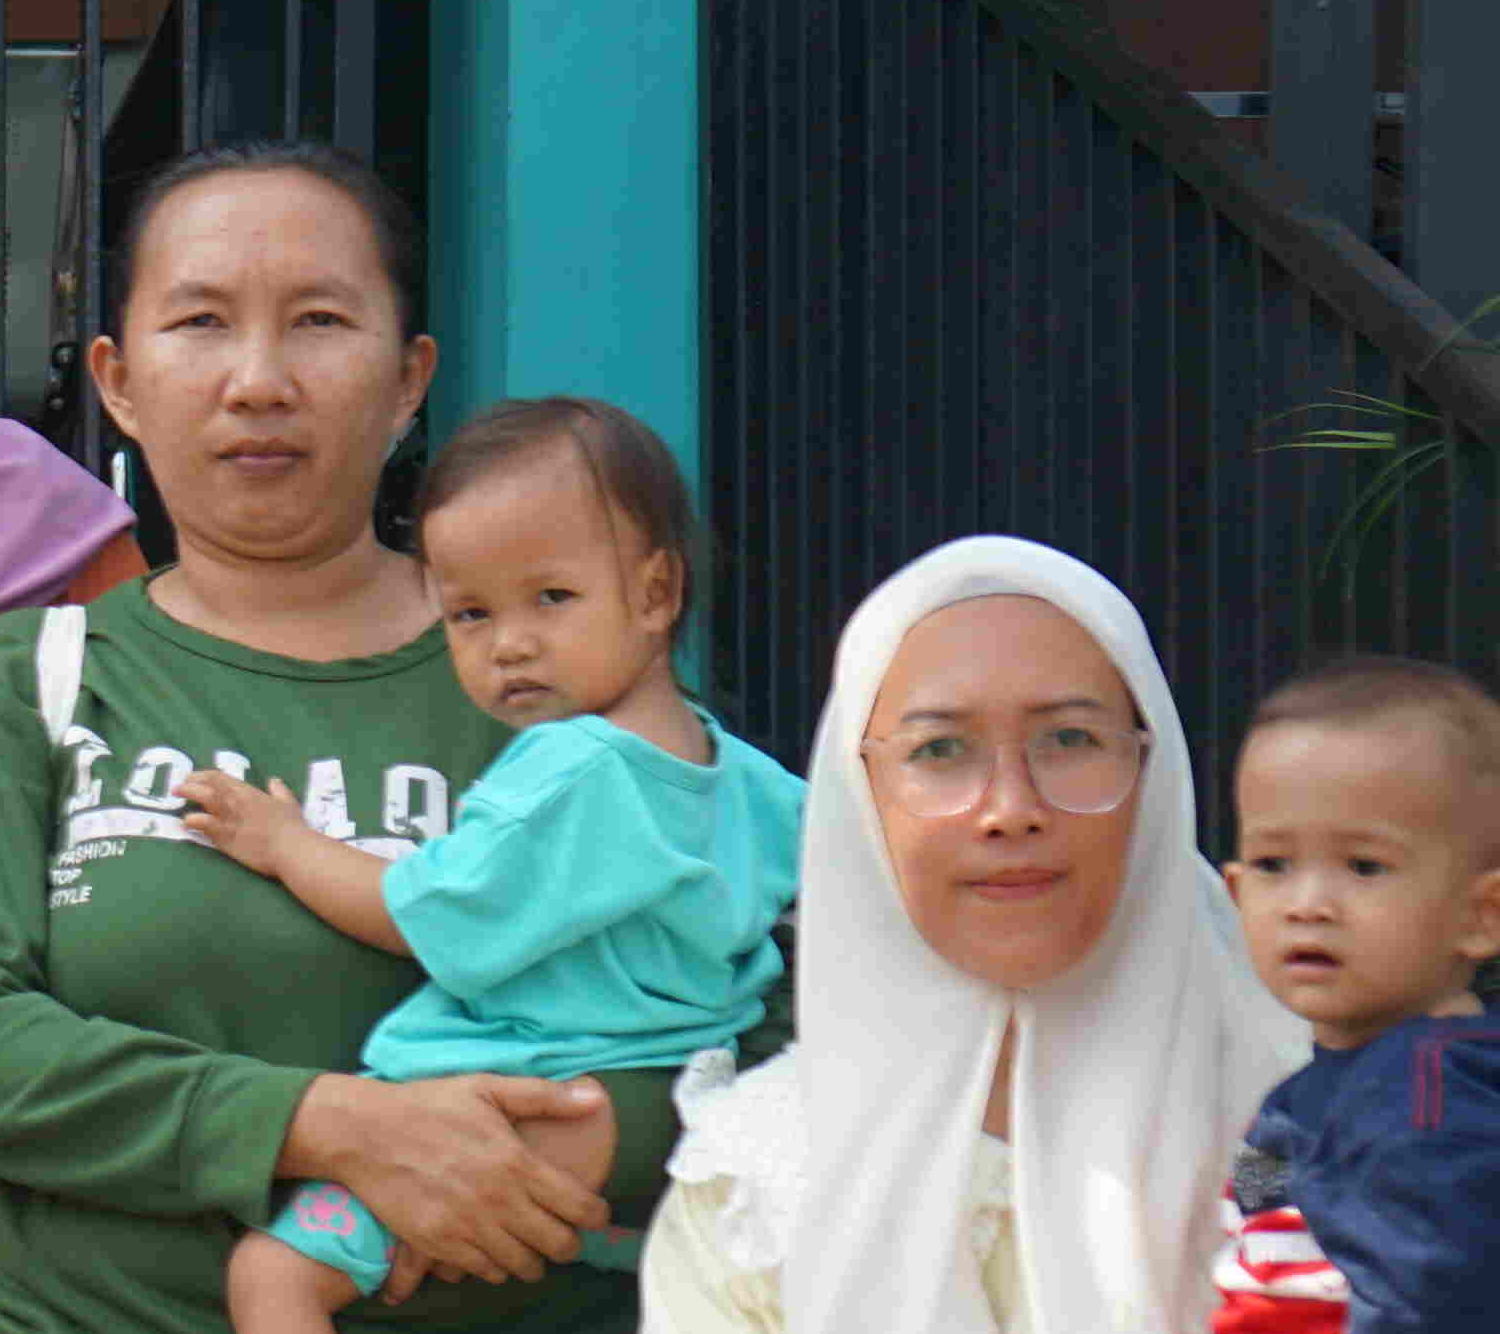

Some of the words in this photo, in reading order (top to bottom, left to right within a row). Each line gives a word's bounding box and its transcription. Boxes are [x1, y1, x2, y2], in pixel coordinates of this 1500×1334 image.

[57, 840, 128, 867] FASHION
[51, 867, 82, 887] TOP
[49, 885, 93, 909] STYLE
